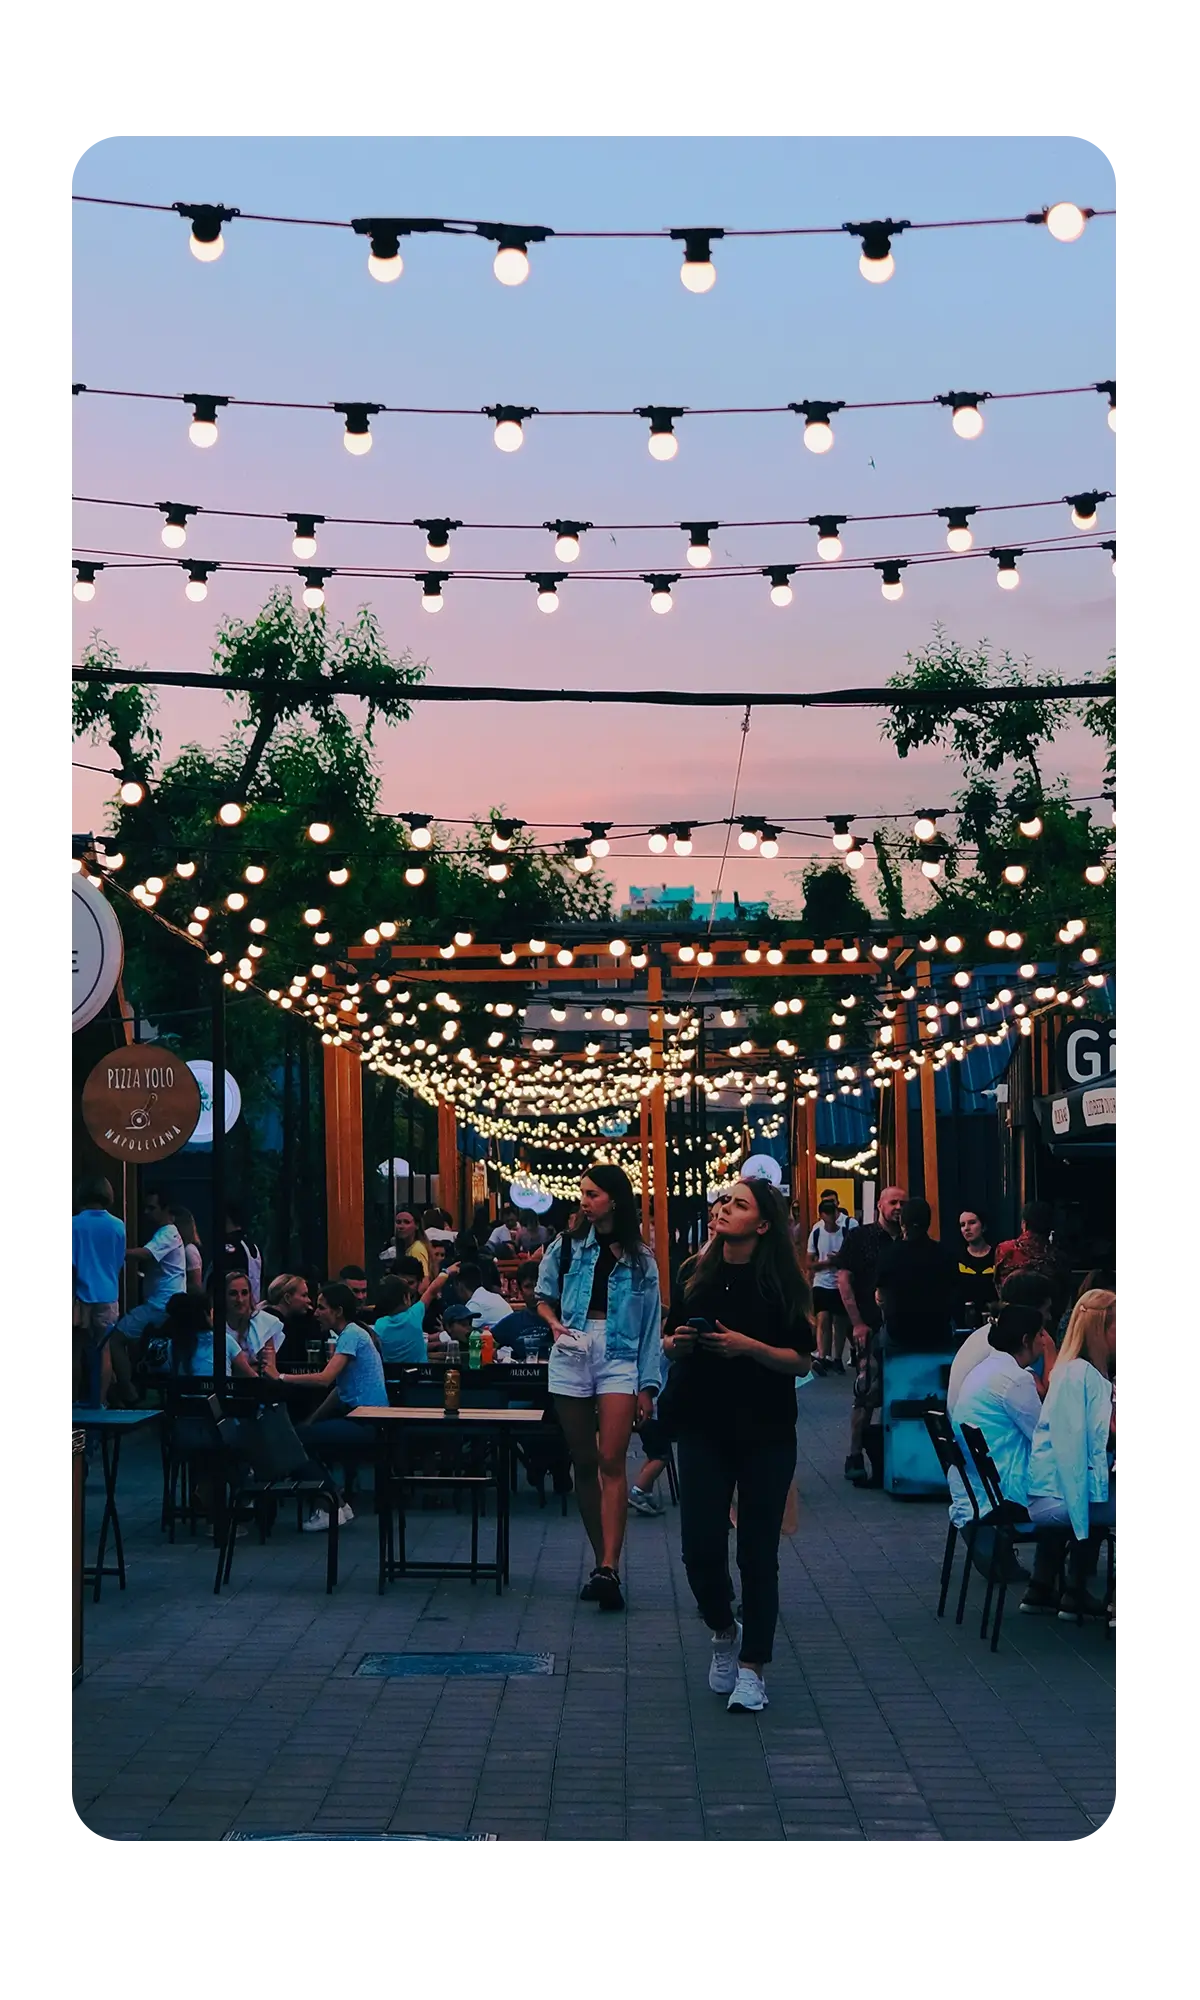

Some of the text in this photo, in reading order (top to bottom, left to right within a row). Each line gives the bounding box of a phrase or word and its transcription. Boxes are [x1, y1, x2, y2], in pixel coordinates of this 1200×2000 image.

[107, 1066, 174, 1089] PIZZA YOLO
[104, 1124, 182, 1151] NAPOLETANA
